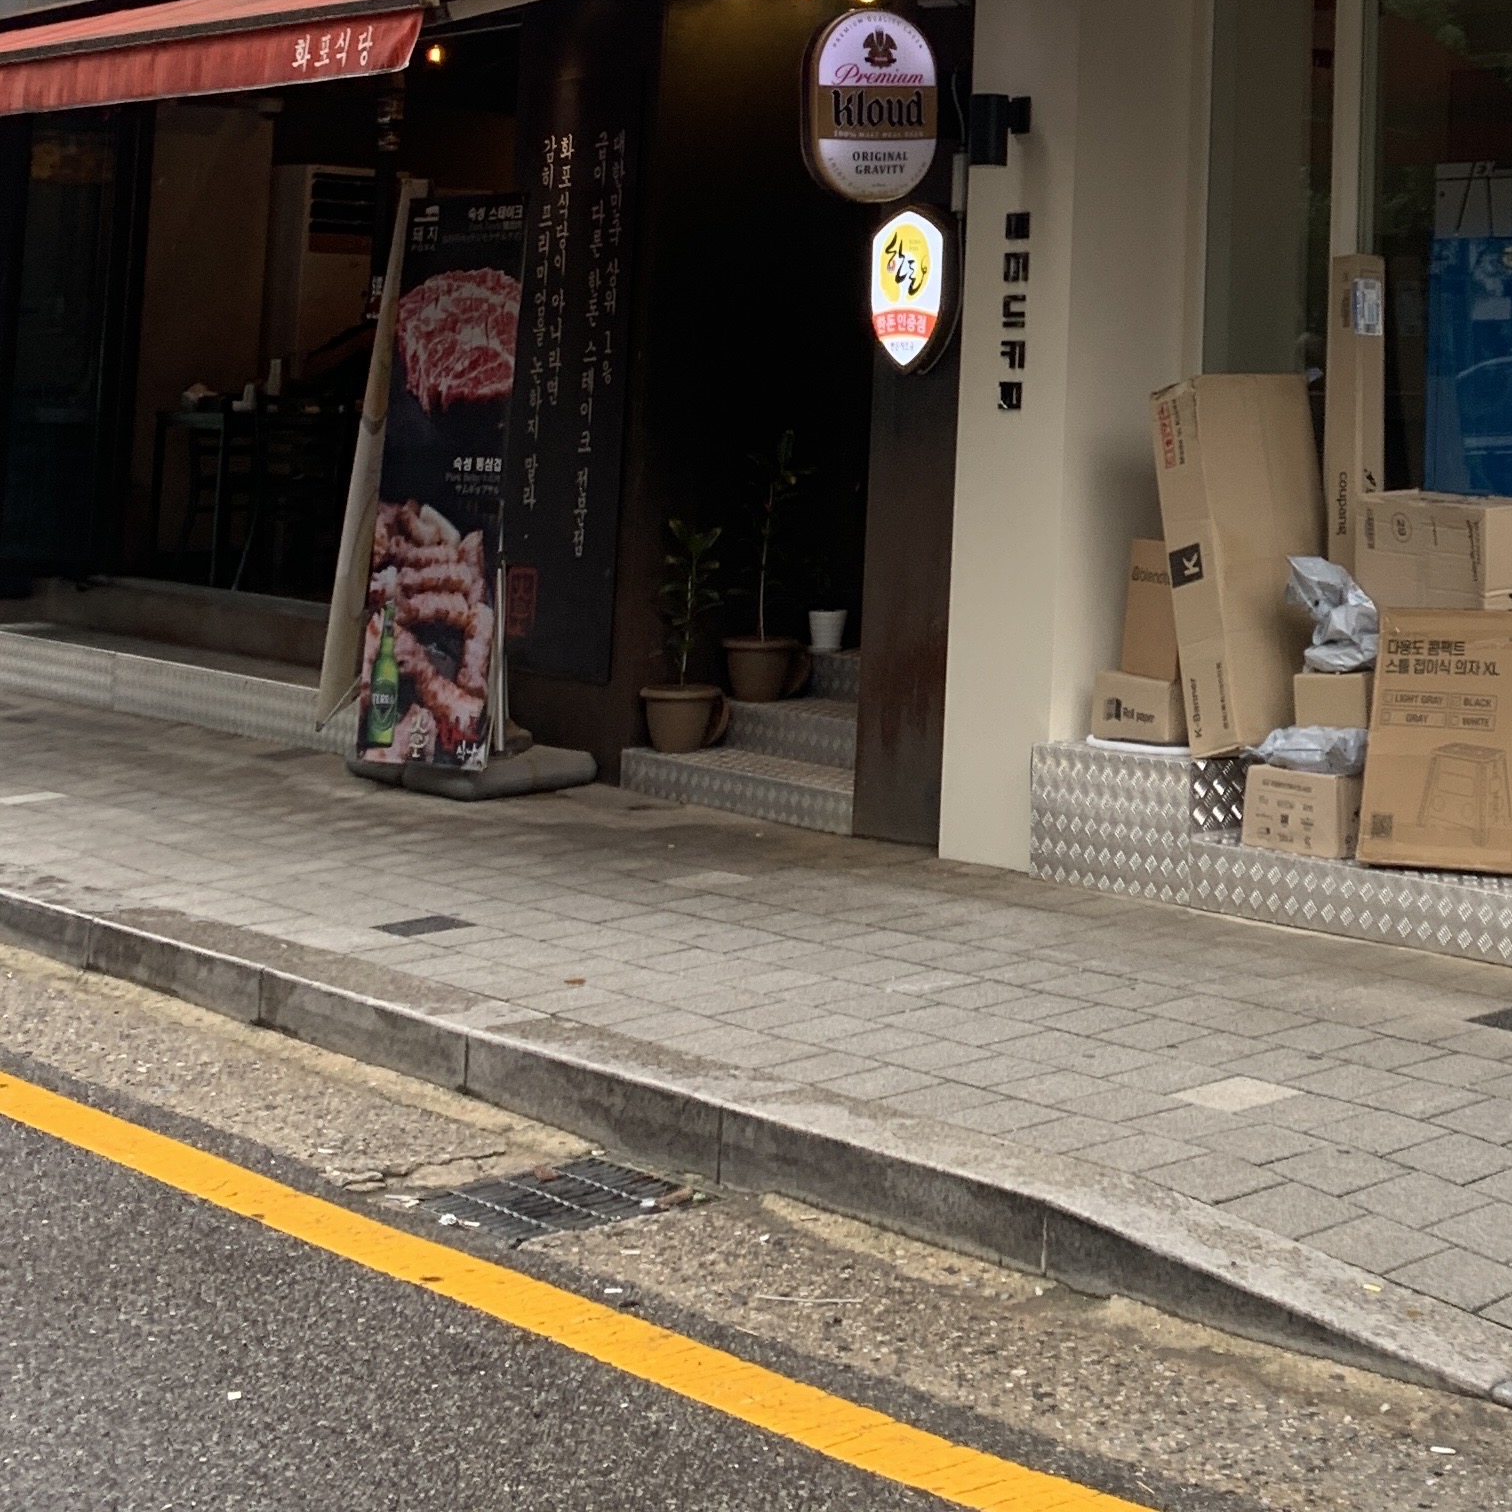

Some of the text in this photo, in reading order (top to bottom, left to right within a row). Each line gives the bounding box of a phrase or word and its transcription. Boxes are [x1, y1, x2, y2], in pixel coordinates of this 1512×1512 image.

[291, 25, 374, 73] 화포식당
[831, 62, 925, 86] Premium
[831, 89, 925, 127] Kloud
[852, 150, 910, 162] ORIGINAL
[855, 164, 906, 175] GRAVITY
[1336, 471, 1348, 536] coupang
[1182, 553, 1200, 577] K
[1413, 658, 1452, 676] 접이식
[1454, 658, 1481, 676] 의자
[1482, 660, 1501, 677] XL
[1463, 696, 1492, 708] BLACK
